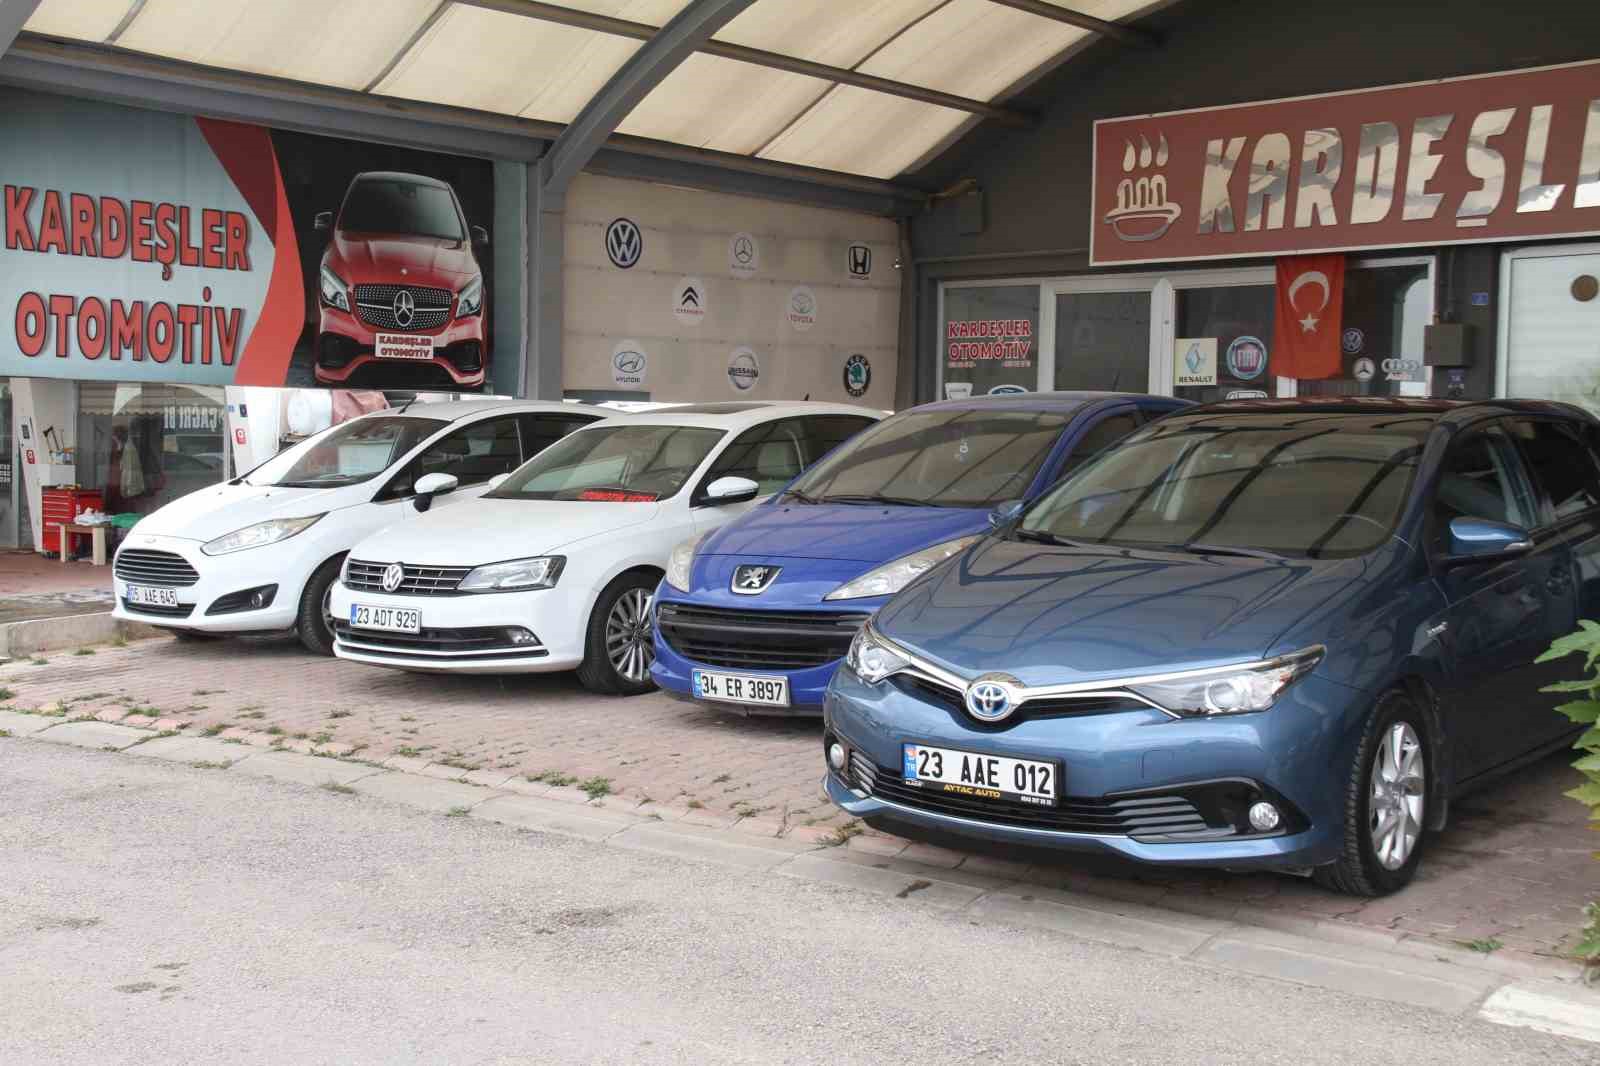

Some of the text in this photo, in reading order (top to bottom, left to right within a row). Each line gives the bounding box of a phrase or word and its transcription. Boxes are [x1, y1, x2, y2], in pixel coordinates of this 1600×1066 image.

[4, 184, 252, 280] KARDEŞLER
[14, 286, 242, 366] OTOMOTİV
[1178, 375, 1213, 384] RENAULT
[357, 607, 417, 628] 23 ADT 929
[702, 676, 782, 701] 34 ER 3897
[918, 750, 1051, 795] 23 AAE 012
[976, 788, 1001, 799] AUTO
